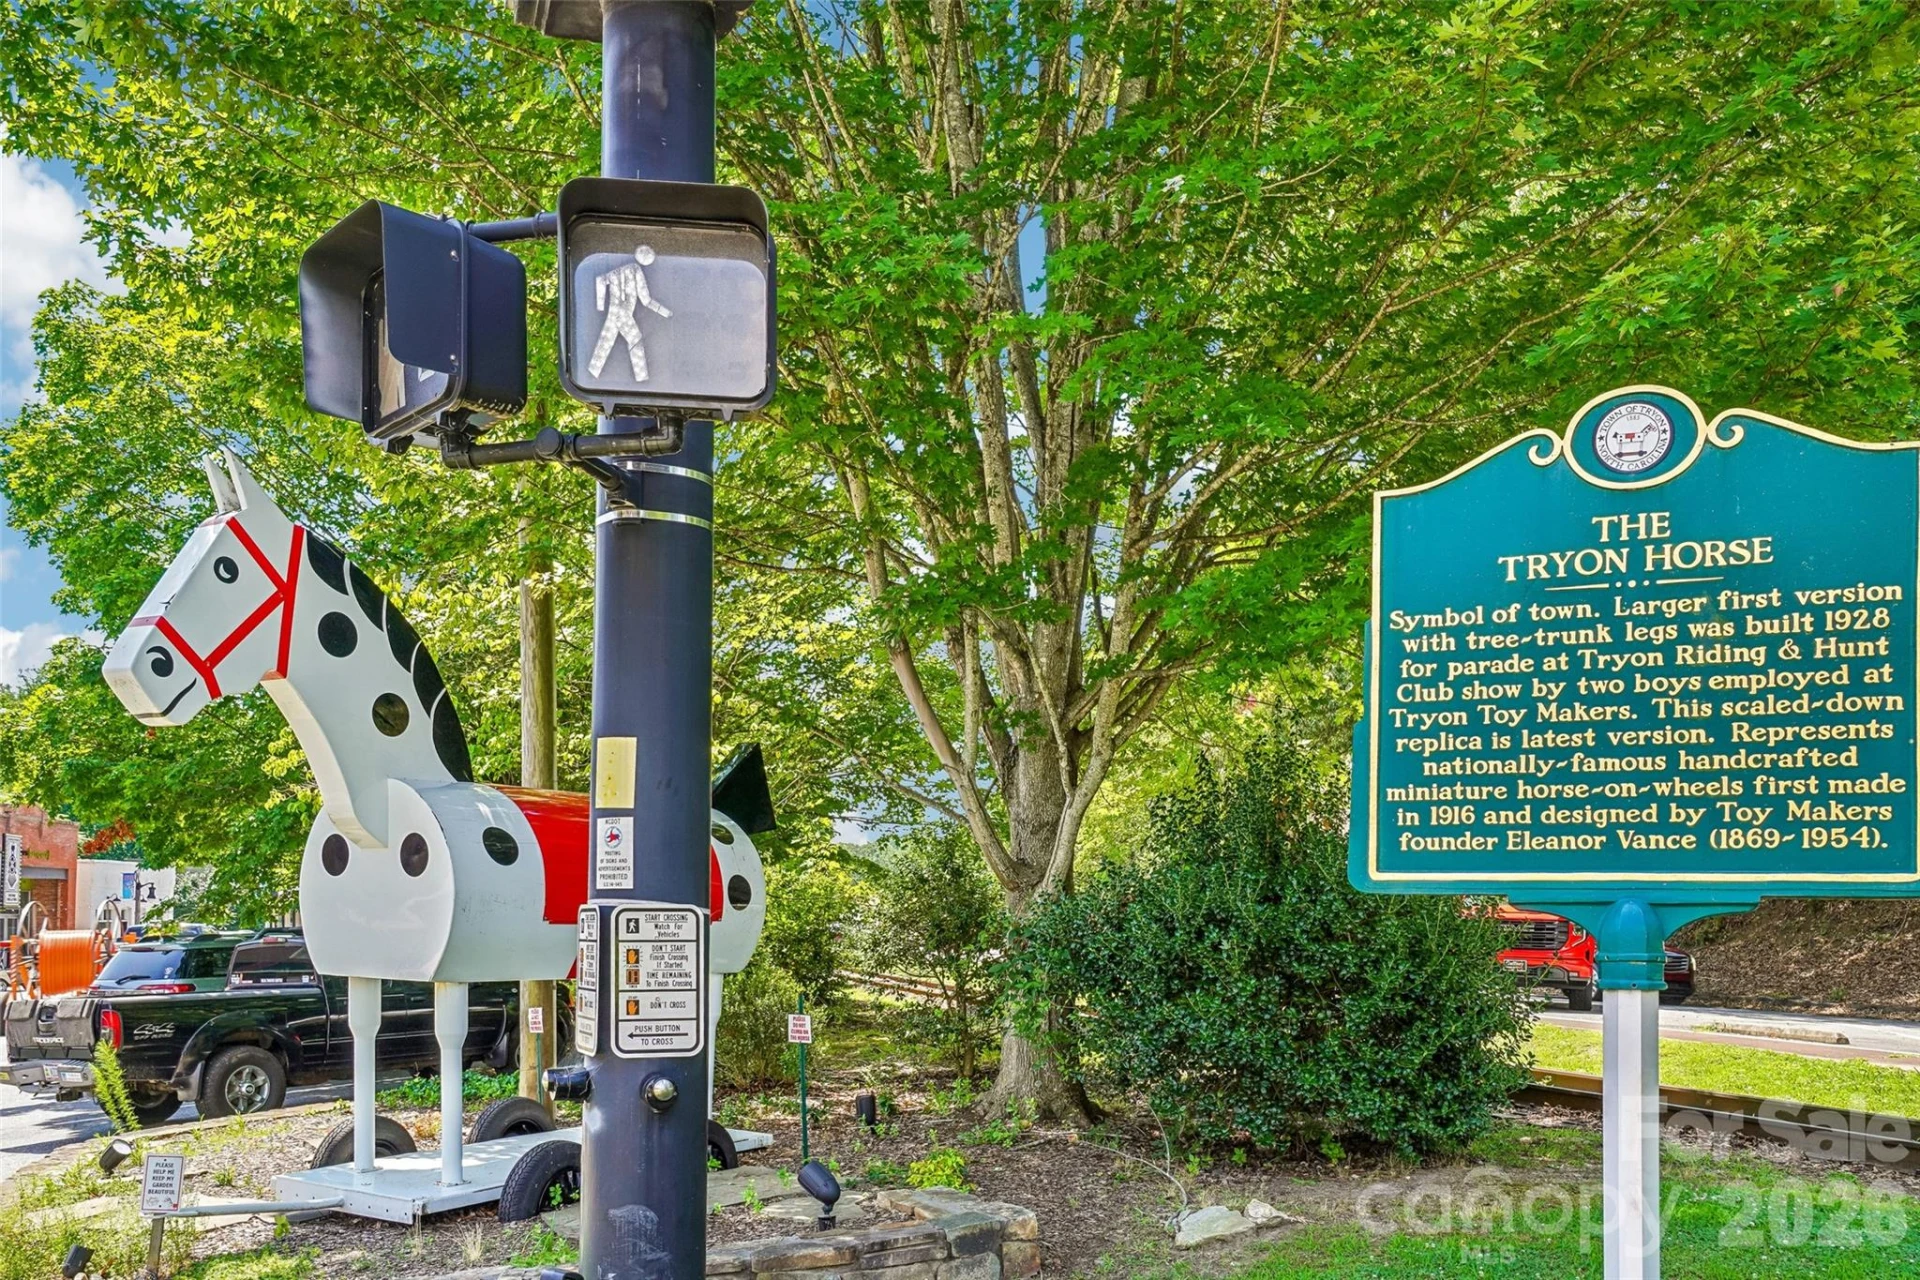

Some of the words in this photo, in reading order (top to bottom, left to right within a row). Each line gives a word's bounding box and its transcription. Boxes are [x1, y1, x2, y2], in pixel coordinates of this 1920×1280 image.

[1600, 409, 1623, 433] TOWN
[1626, 405, 1639, 413] OF
[1639, 405, 1667, 427] TRYON
[1598, 443, 1624, 470] NORTH
[1627, 438, 1668, 470] CAROLINA
[1592, 512, 1670, 542] THE
[1498, 548, 1629, 581] TRYON
[1645, 537, 1773, 571] HORSE
[1390, 606, 1483, 632] Symbol
[1492, 603, 1521, 623] of
[1529, 603, 1599, 620] town.
[1614, 596, 1707, 618] Larger
[1717, 589, 1781, 610] first
[1795, 583, 1902, 605] version
[1403, 633, 1455, 652] with
[1626, 622, 1677, 644] legs
[1688, 622, 1734, 638] was
[1745, 613, 1814, 635] built
[1825, 608, 1890, 630] 1928
[1400, 659, 1437, 677] for
[1448, 654, 1534, 680] parade
[1543, 653, 1568, 671] at
[1578, 649, 1664, 671] Tryon
[1676, 644, 1766, 666] Riding
[1779, 639, 1801, 659] &
[1814, 637, 1889, 658] Hunt
[1397, 682, 1453, 702] Club
[1462, 681, 1522, 700] show
[1532, 678, 1566, 700] by
[1577, 677, 1624, 694] two
[1634, 674, 1701, 695] boys
[1709, 664, 1849, 694] employed
[1864, 664, 1893, 683] at
[1389, 709, 1467, 730] Tryon
[1477, 705, 1527, 727] Toy
[1537, 703, 1637, 722] Makers.
[1652, 698, 1712, 718] This
[1396, 732, 1482, 756] replica
[1492, 732, 1510, 749] is
[1522, 729, 1595, 748] latest
[1607, 726, 1714, 745] version.
[1732, 719, 1893, 746] Represents
[1679, 746, 1858, 769] handcrafted
[1387, 782, 1507, 801] miniature
[1753, 775, 1805, 794] first
[1828, 773, 1905, 793] made
[1397, 809, 1419, 825] in
[1431, 805, 1475, 825] 1916
[1484, 805, 1531, 824] and
[1541, 804, 1657, 828] designed
[1669, 803, 1706, 826] by
[1716, 802, 1773, 825] Toy
[1787, 800, 1892, 820] Makers
[1399, 832, 1498, 850] founder
[1507, 831, 1606, 850] Eleanor
[1617, 830, 1696, 849] Vance
[650, 953, 666, 961] Finish
[667, 953, 688, 963] Crossing
[651, 944, 668, 952] DON'T
[669, 944, 686, 952] START
[646, 971, 659, 979] TIME
[661, 971, 692, 979] REMAINING
[663, 961, 683, 969] Started
[646, 979, 652, 987] To
[672, 980, 693, 989] Crossing
[650, 1001, 667, 1009] DON'T
[669, 1001, 686, 1009] CROSS
[640, 1038, 650, 1046] TO
[651, 1037, 674, 1046] CROSS
[655, 1024, 681, 1032] BUTTON
